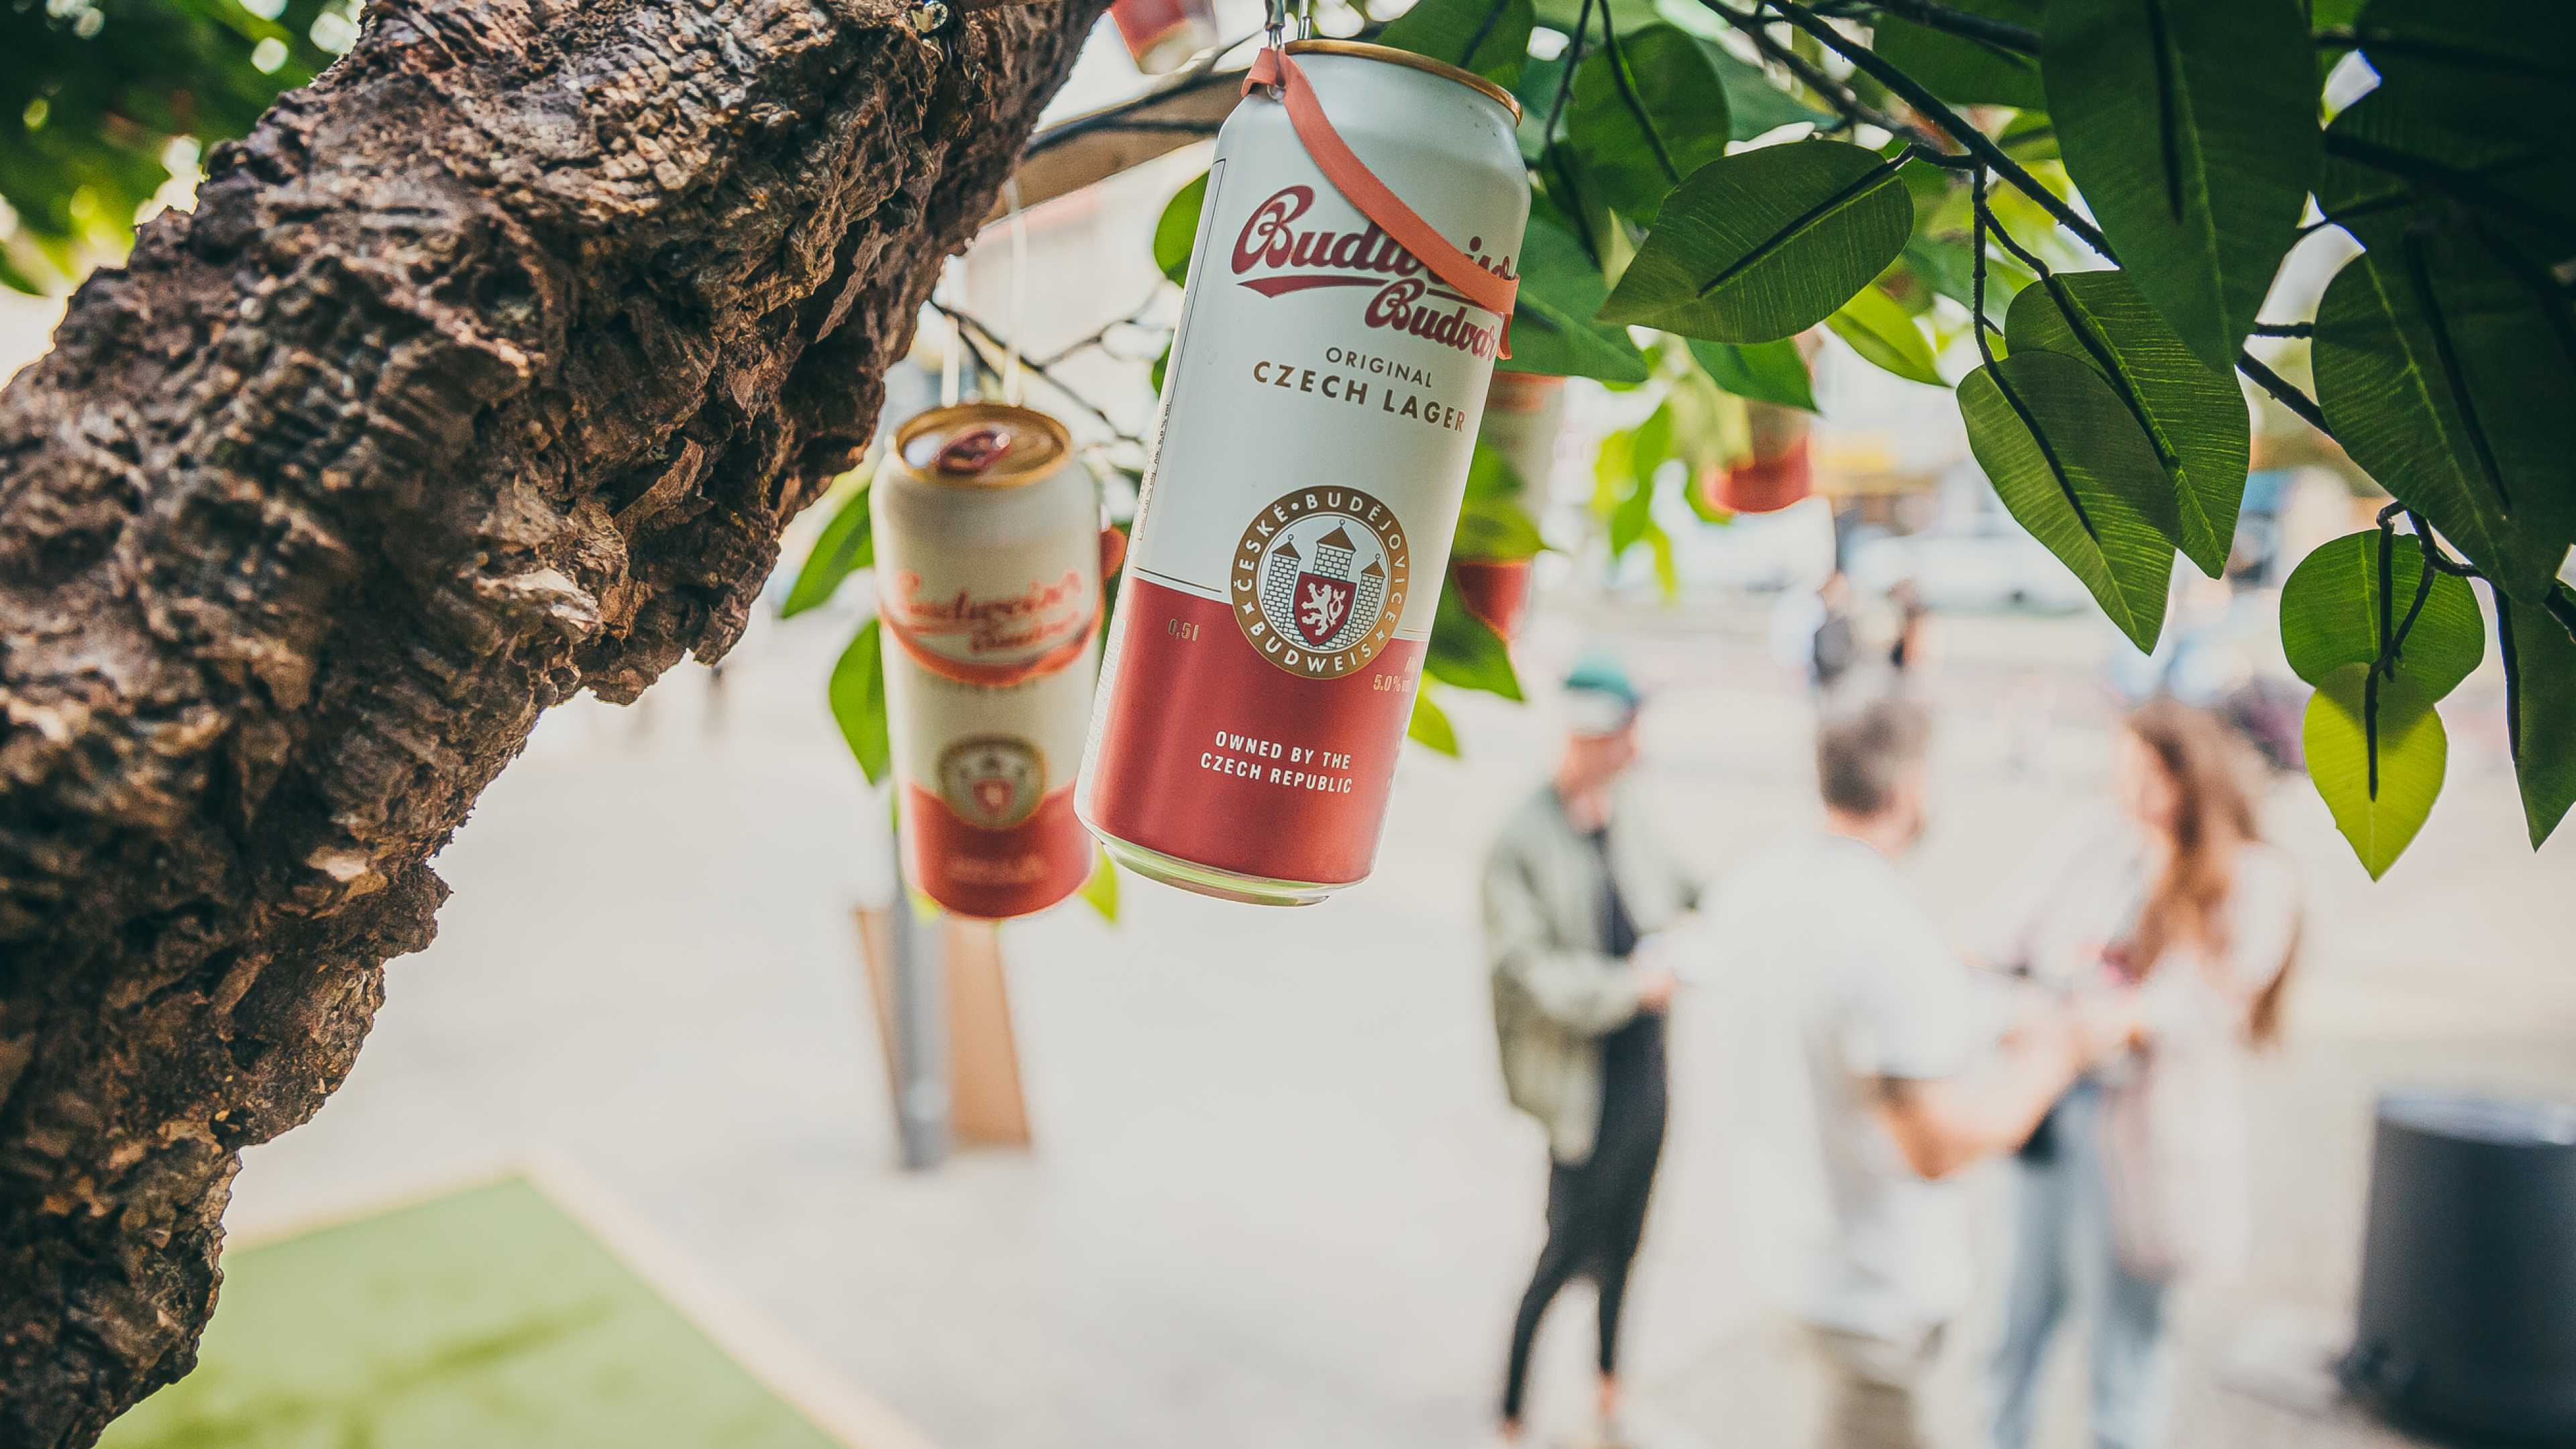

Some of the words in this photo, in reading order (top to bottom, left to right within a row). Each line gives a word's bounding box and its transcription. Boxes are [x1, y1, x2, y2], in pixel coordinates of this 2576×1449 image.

[1364, 278, 1497, 361] Budvar
[1326, 347, 1432, 388] ORIGINAL
[1253, 361, 1368, 405] CZECH
[1383, 389, 1465, 432] LAGER
[1234, 504, 1289, 592] ČESKÉ
[1305, 492, 1407, 623] BUDĚJOVICE
[1250, 621, 1372, 673] BUDWEIS
[1200, 752, 1262, 780] CZECH
[1269, 767, 1352, 794] REPUBLIC
[1215, 730, 1282, 759] OWNED
[1290, 746, 1315, 765] BY
[1322, 751, 1351, 770] THE
